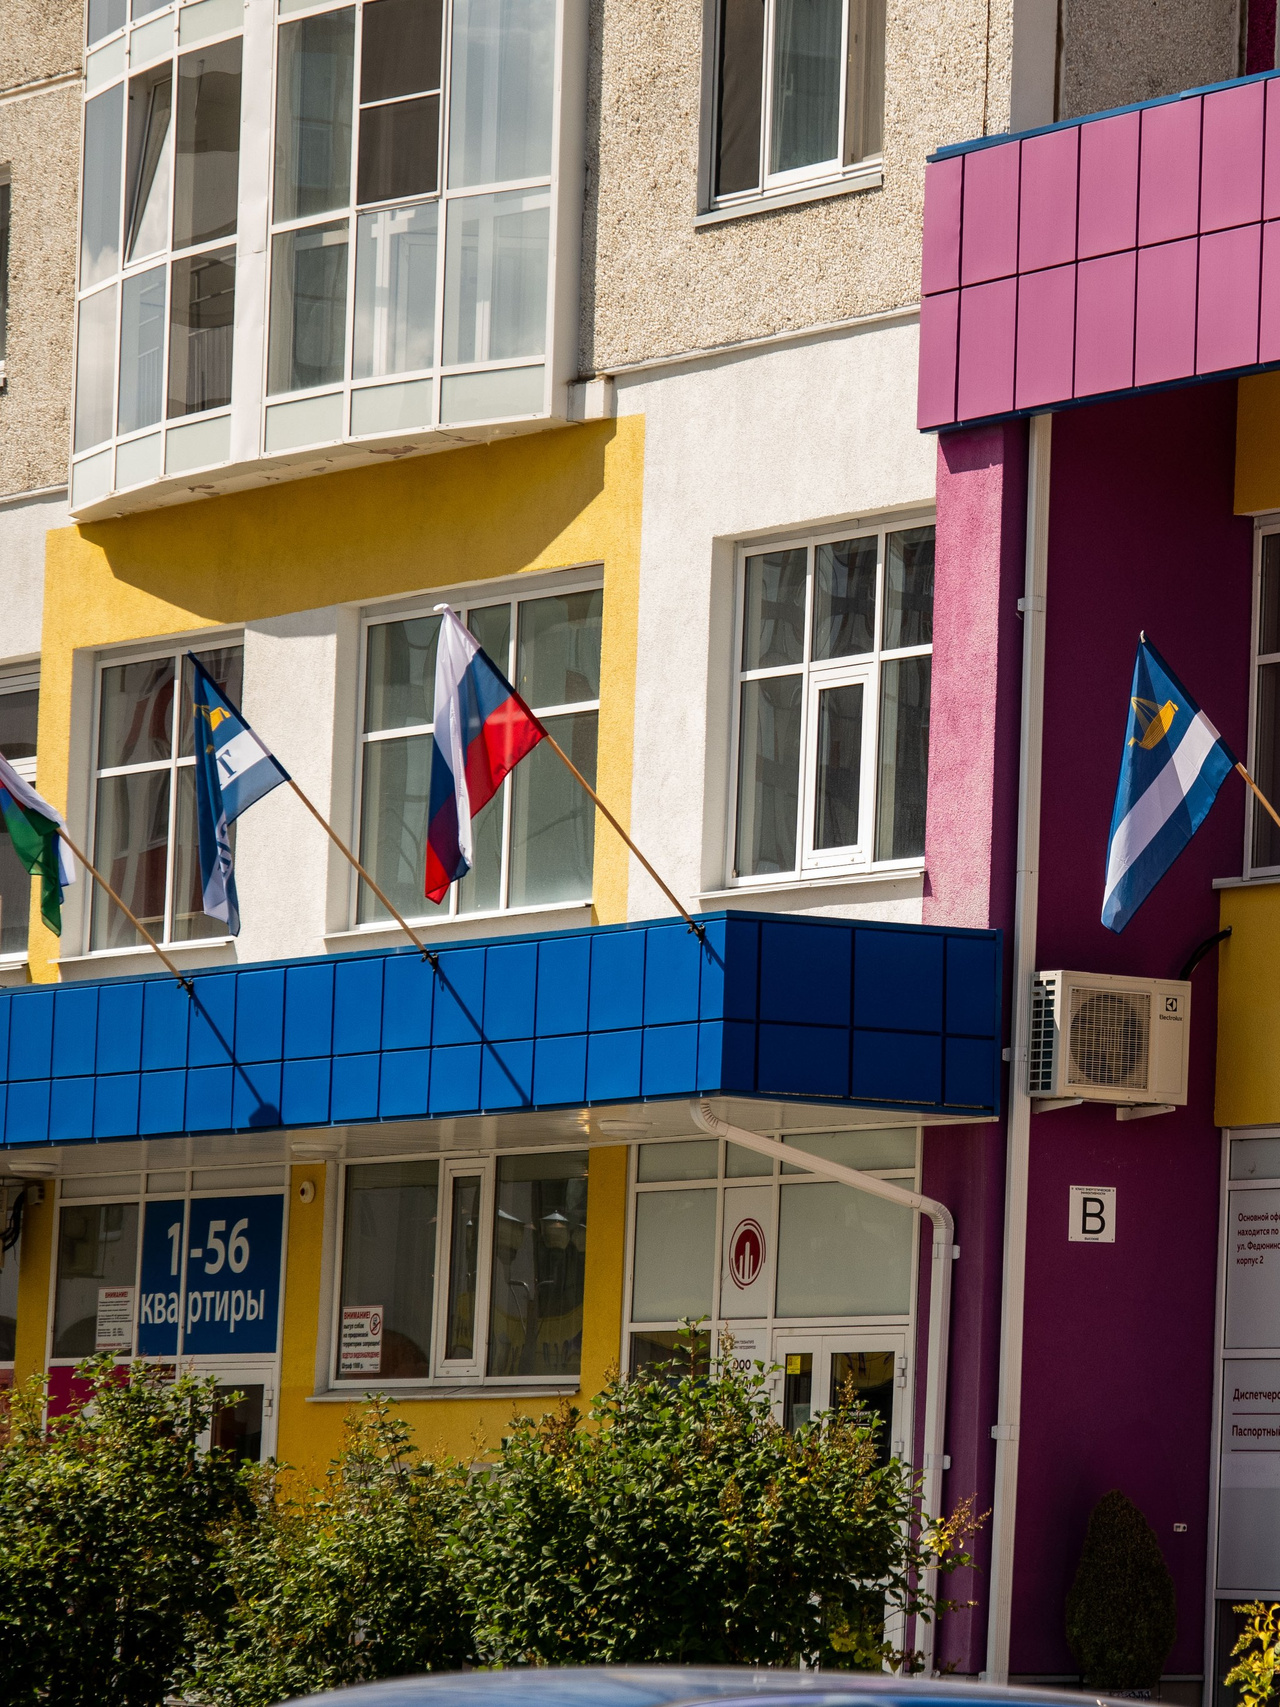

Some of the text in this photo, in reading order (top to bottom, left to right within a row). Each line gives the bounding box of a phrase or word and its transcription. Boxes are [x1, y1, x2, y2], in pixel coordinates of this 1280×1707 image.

[1159, 1013, 1183, 1021] Electrolux
[1237, 1212, 1269, 1222] Основной
[1237, 1228, 1270, 1237] находится
[167, 1217, 250, 1276] 1-56
[1236, 1243, 1246, 1253] ул.
[1236, 1255, 1264, 1267] корпус 2
[140, 1289, 265, 1335] квартиры
